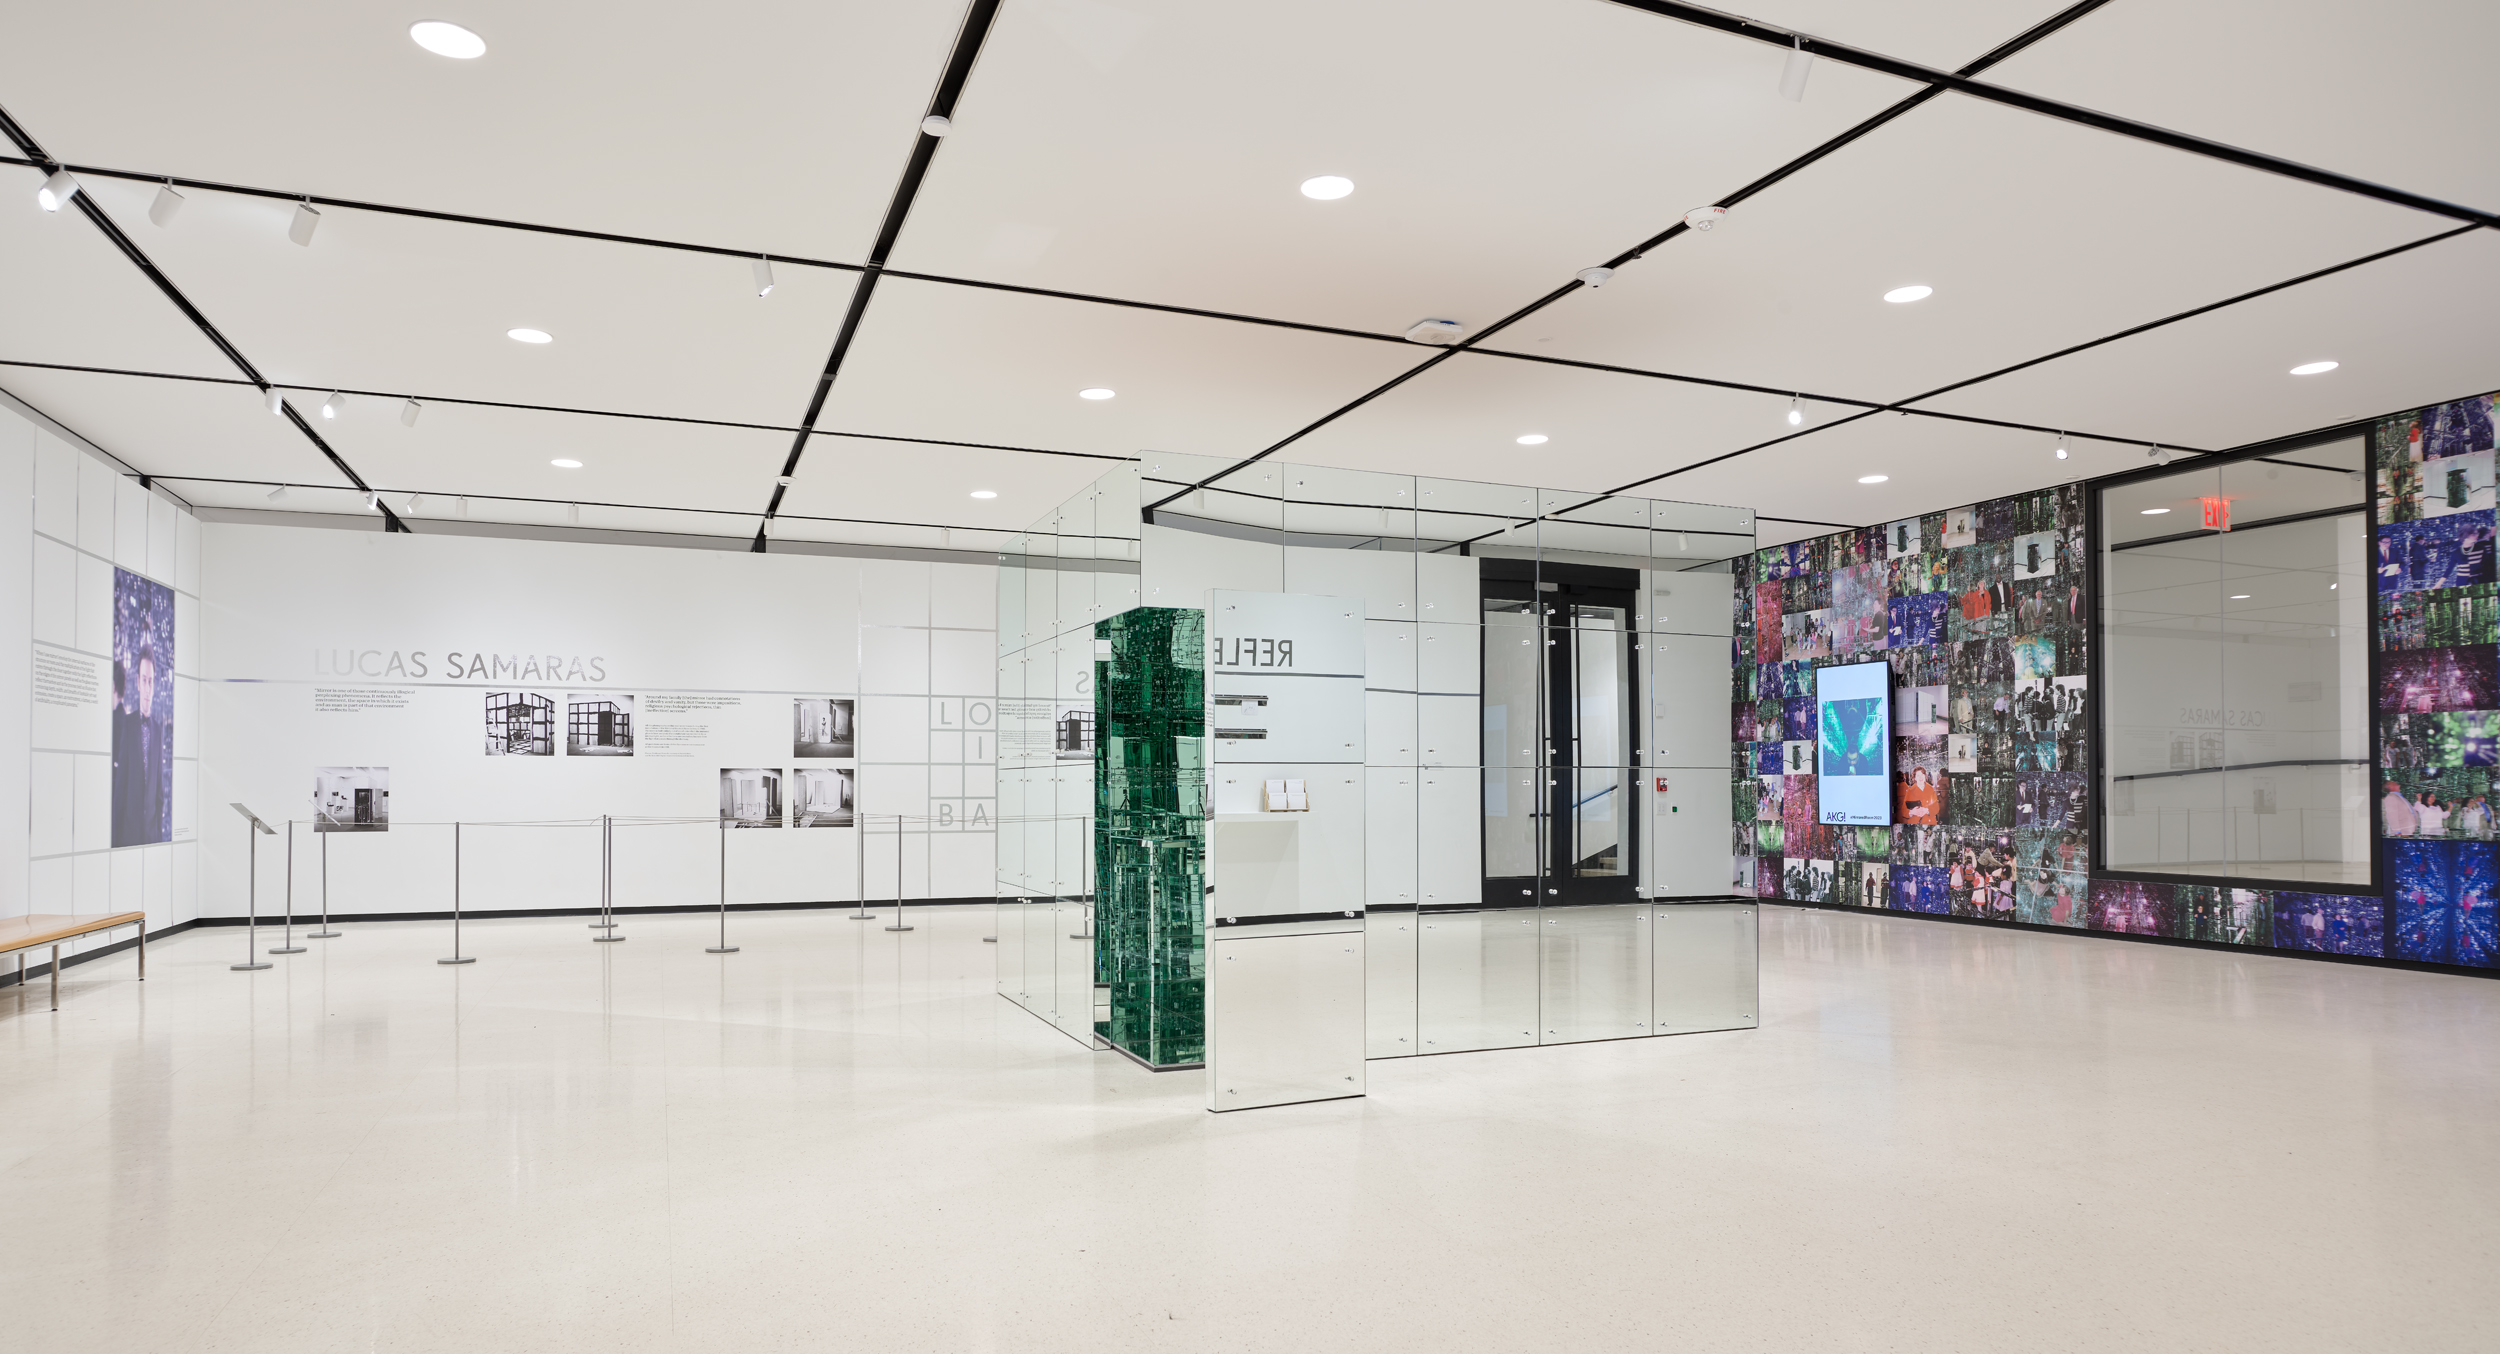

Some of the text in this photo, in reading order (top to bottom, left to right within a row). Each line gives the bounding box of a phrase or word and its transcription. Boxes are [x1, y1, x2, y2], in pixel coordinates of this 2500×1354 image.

[2204, 500, 2227, 528] EXIT
[315, 649, 606, 682] LUCAS SAMARAS
